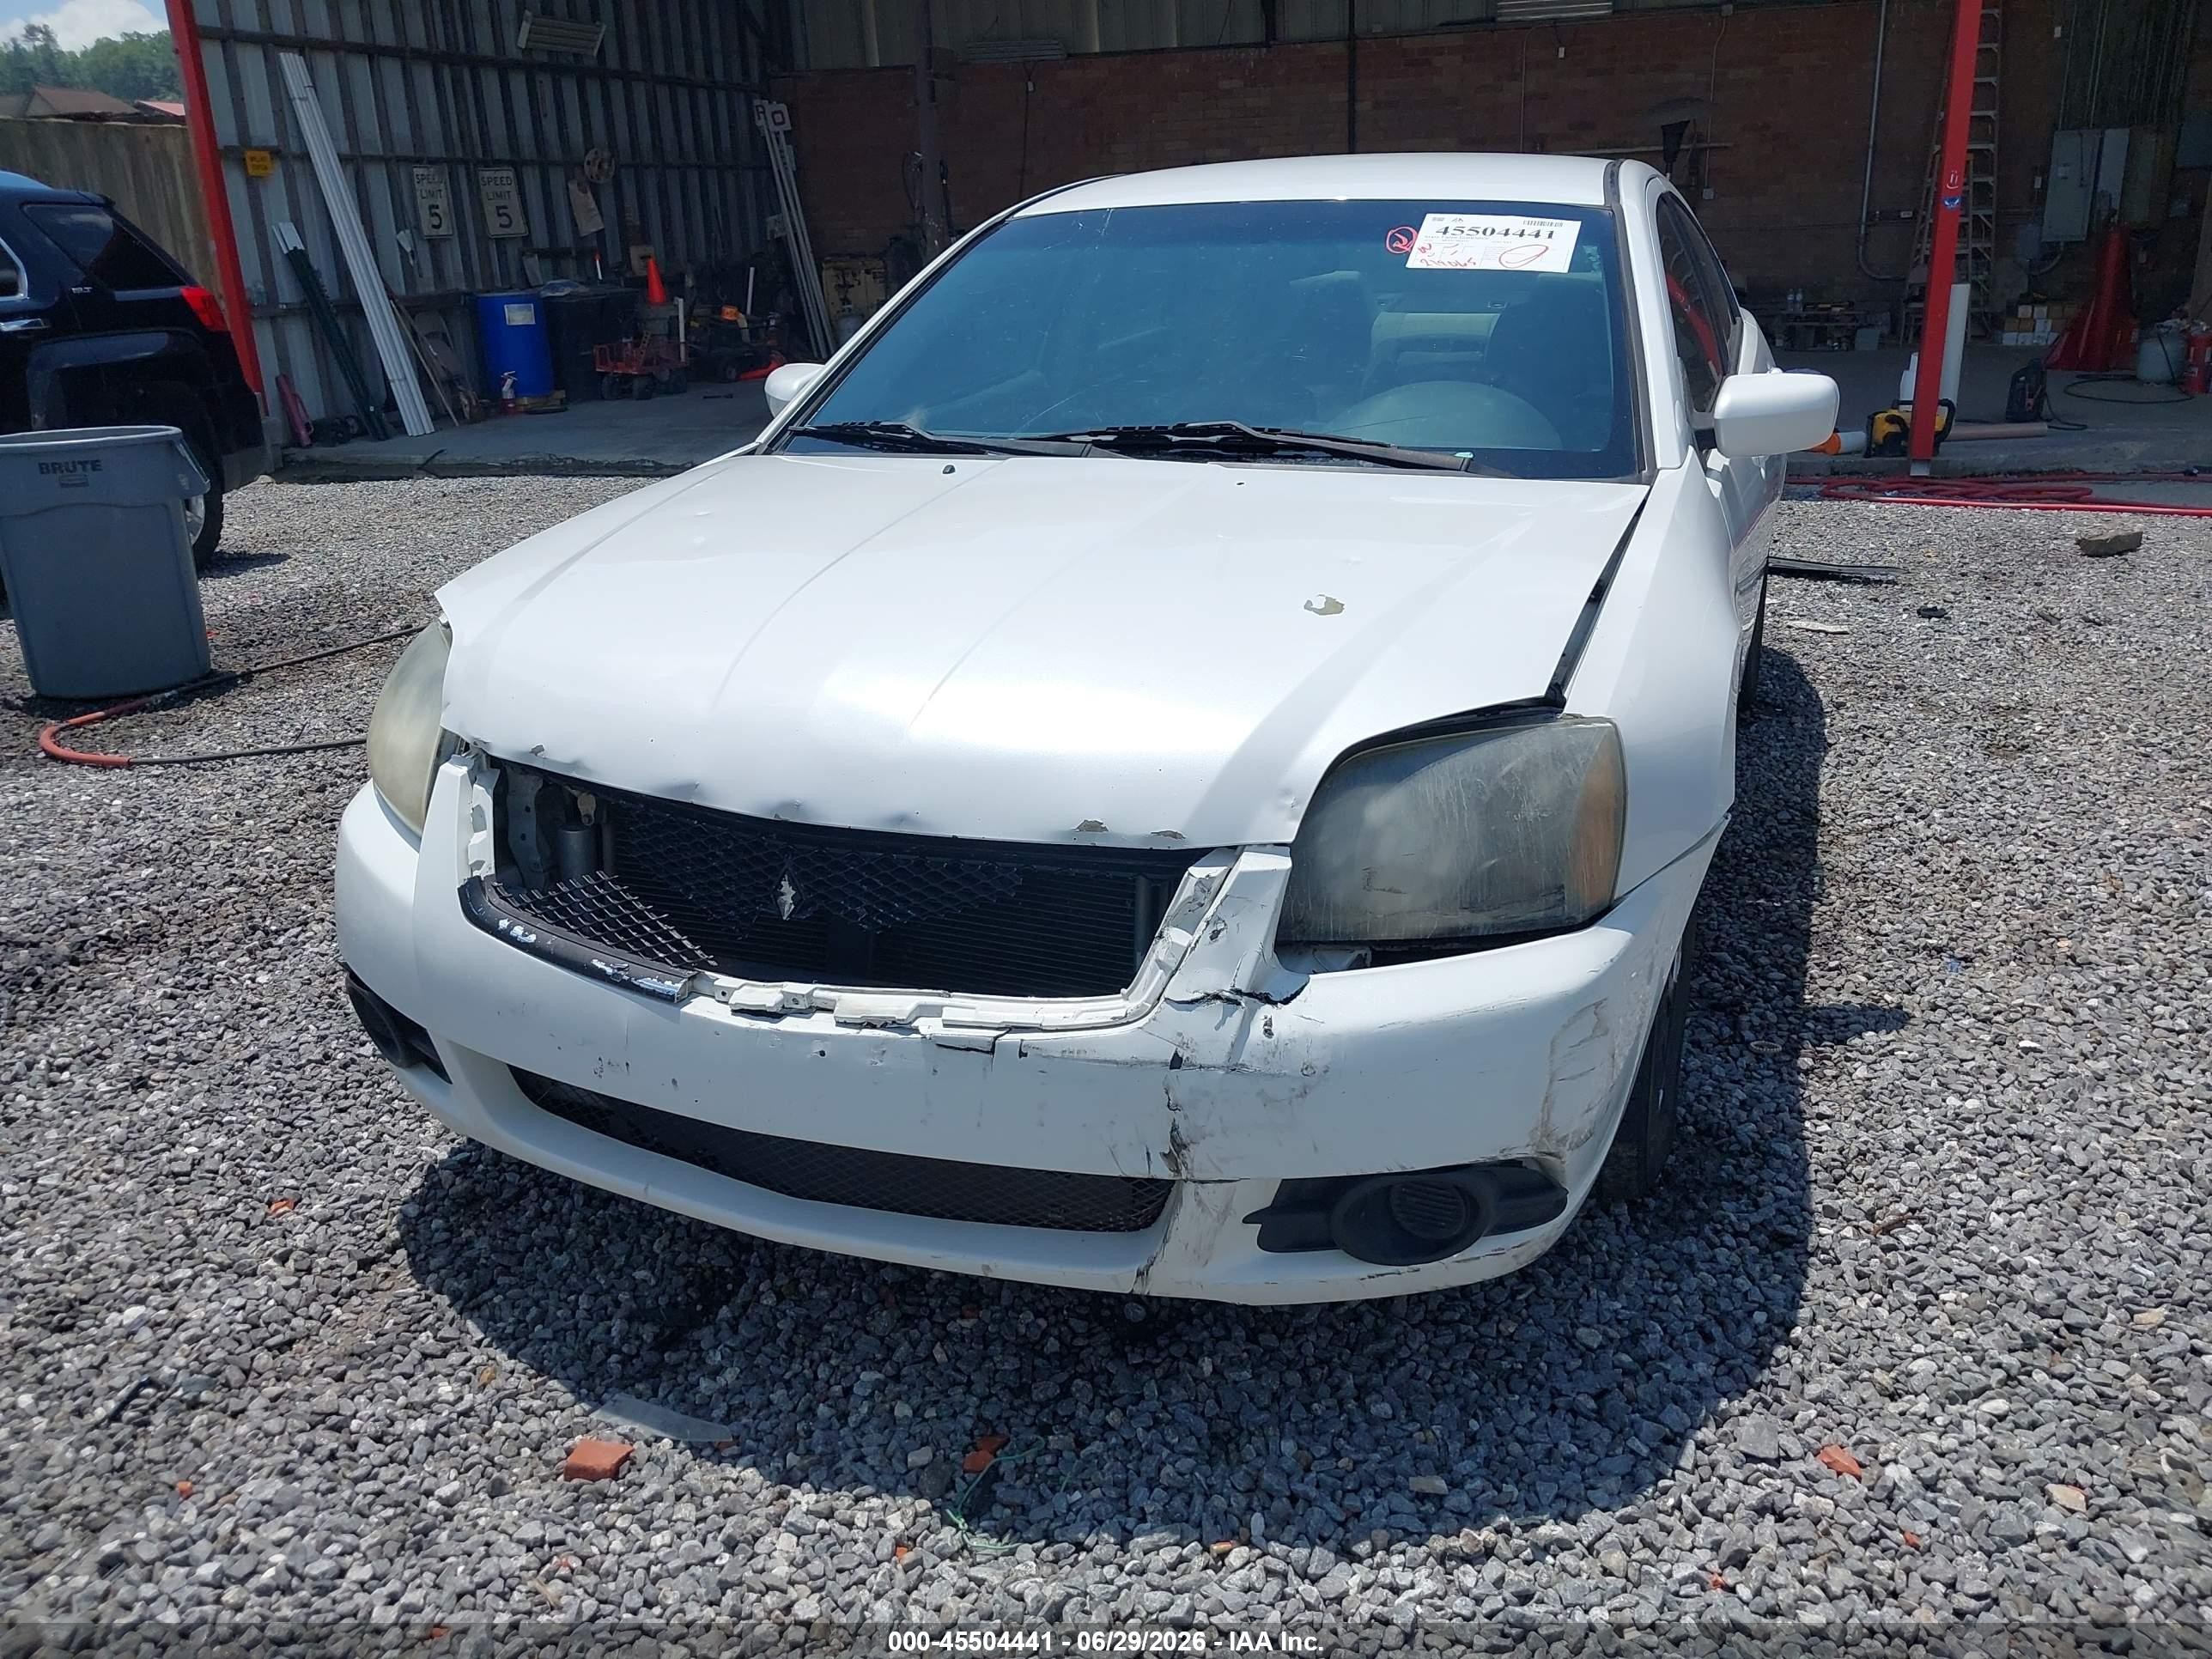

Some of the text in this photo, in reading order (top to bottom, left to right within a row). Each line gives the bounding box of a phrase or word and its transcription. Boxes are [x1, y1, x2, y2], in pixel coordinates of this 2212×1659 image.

[481, 176, 513, 186] SPEED
[420, 189, 442, 199] LIMIT
[486, 191, 512, 201] LIMIT
[428, 204, 442, 229] 5
[495, 205, 513, 228] 5
[1435, 225, 1554, 239] 45504441
[38, 459, 103, 474] BRUTE
